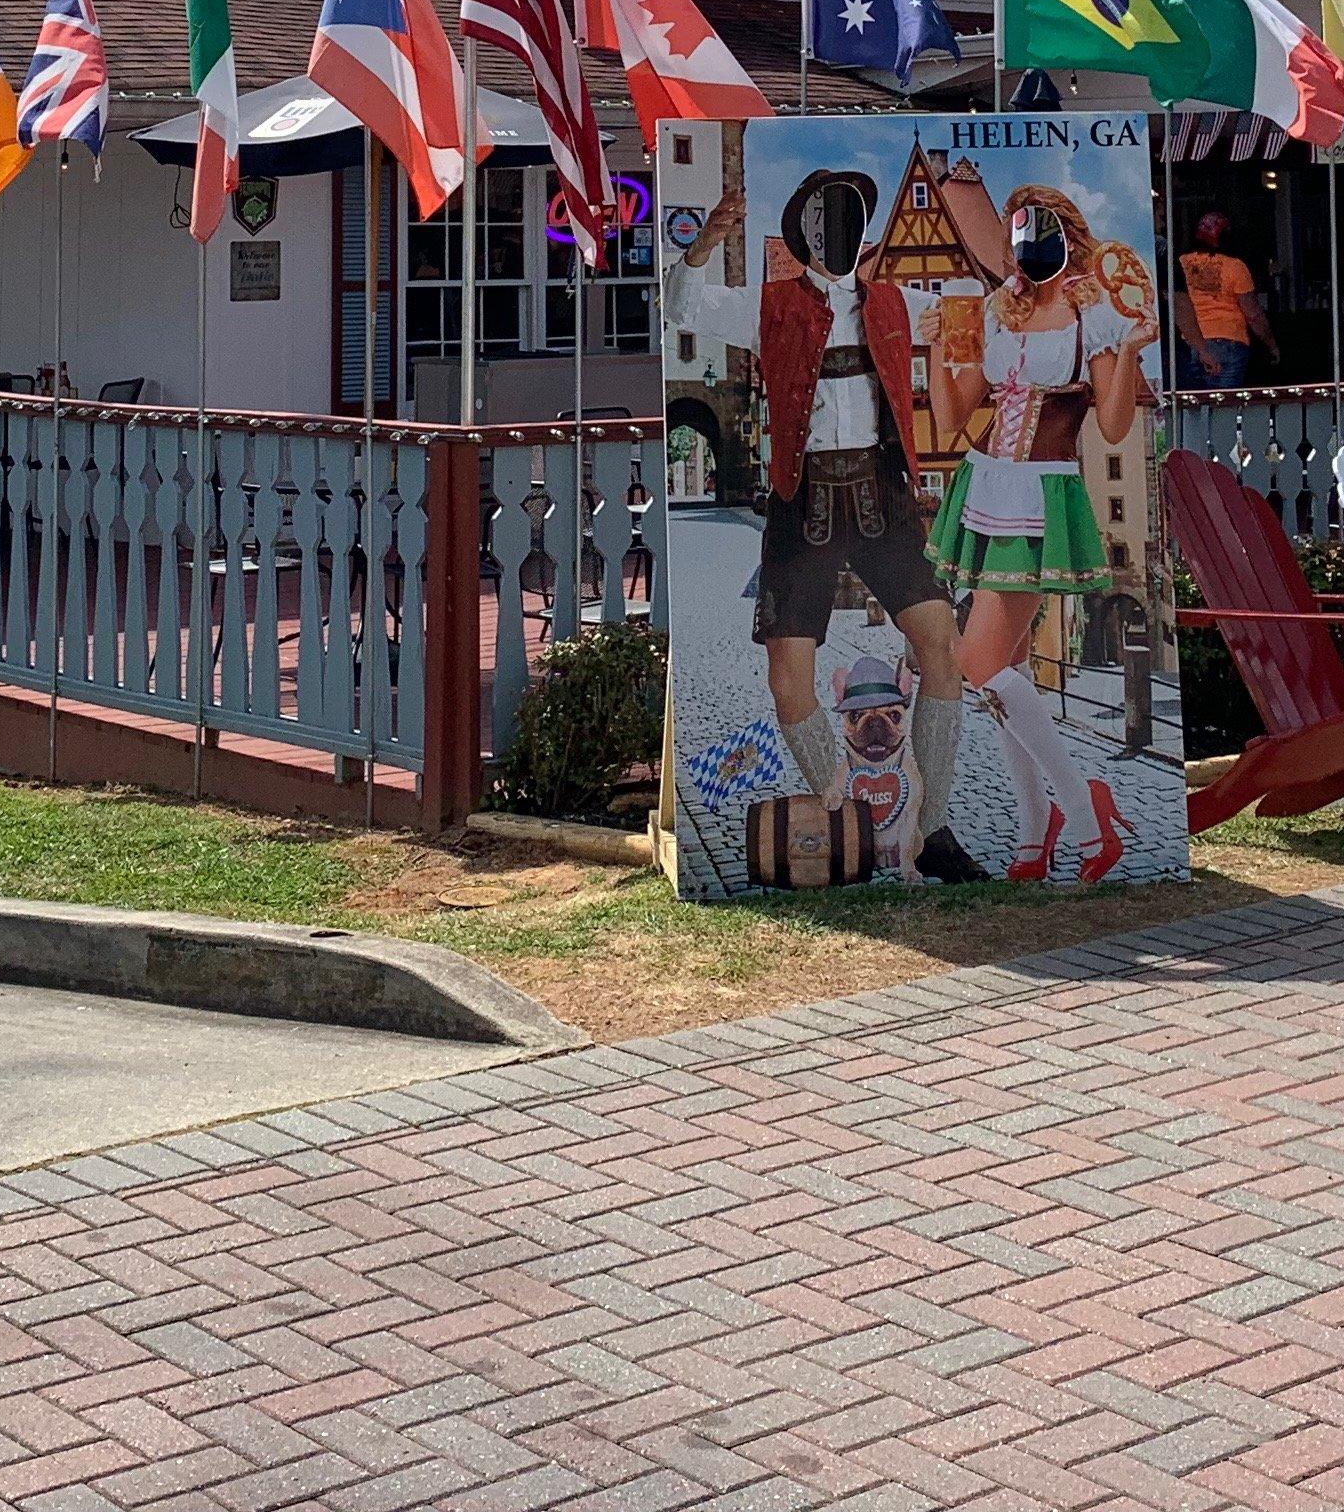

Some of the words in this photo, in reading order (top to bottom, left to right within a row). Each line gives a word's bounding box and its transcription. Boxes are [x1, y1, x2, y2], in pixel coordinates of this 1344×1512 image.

[950, 121, 1080, 152] HELEN,
[1090, 119, 1141, 148] GA
[548, 191, 638, 229] ON
